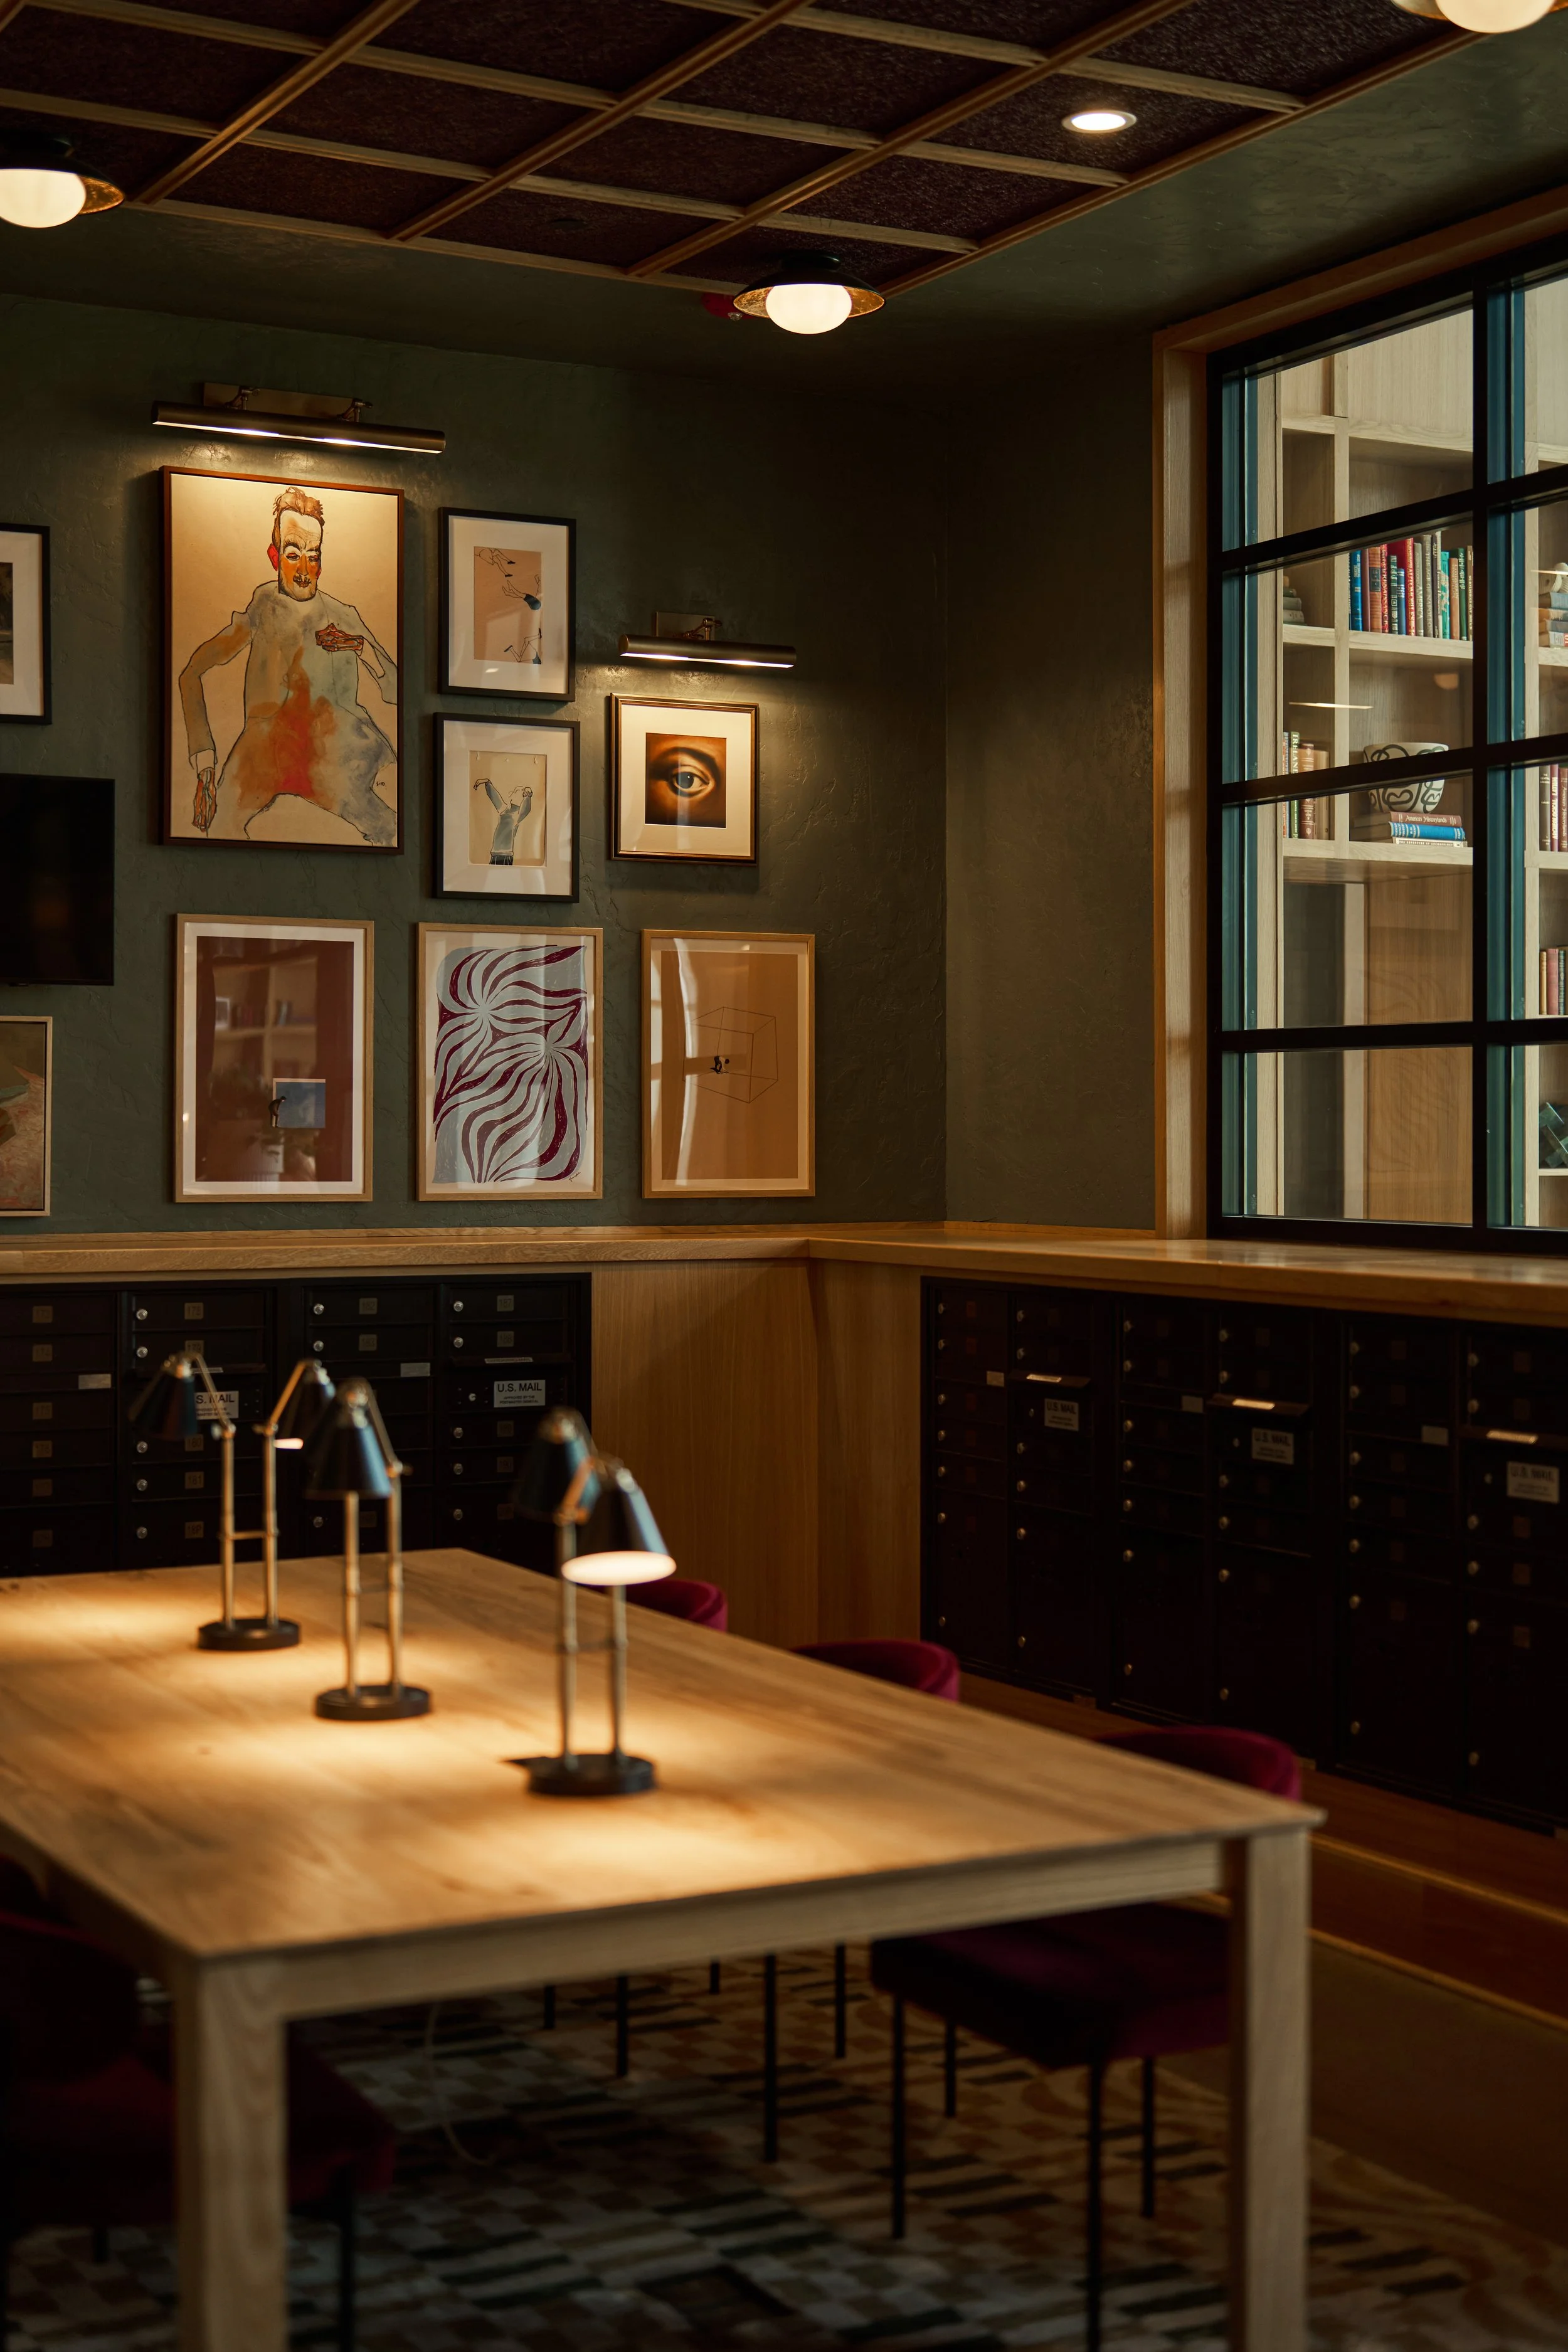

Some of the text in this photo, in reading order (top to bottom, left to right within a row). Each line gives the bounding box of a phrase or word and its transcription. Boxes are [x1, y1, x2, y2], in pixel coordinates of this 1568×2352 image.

[1405, 815, 1448, 824] America's Historylands
[497, 1382, 543, 1392] U.S. MAIL
[196, 1394, 207, 1404] S.
[1060, 1402, 1076, 1414] MAIL
[1271, 1433, 1291, 1447] MAIL
